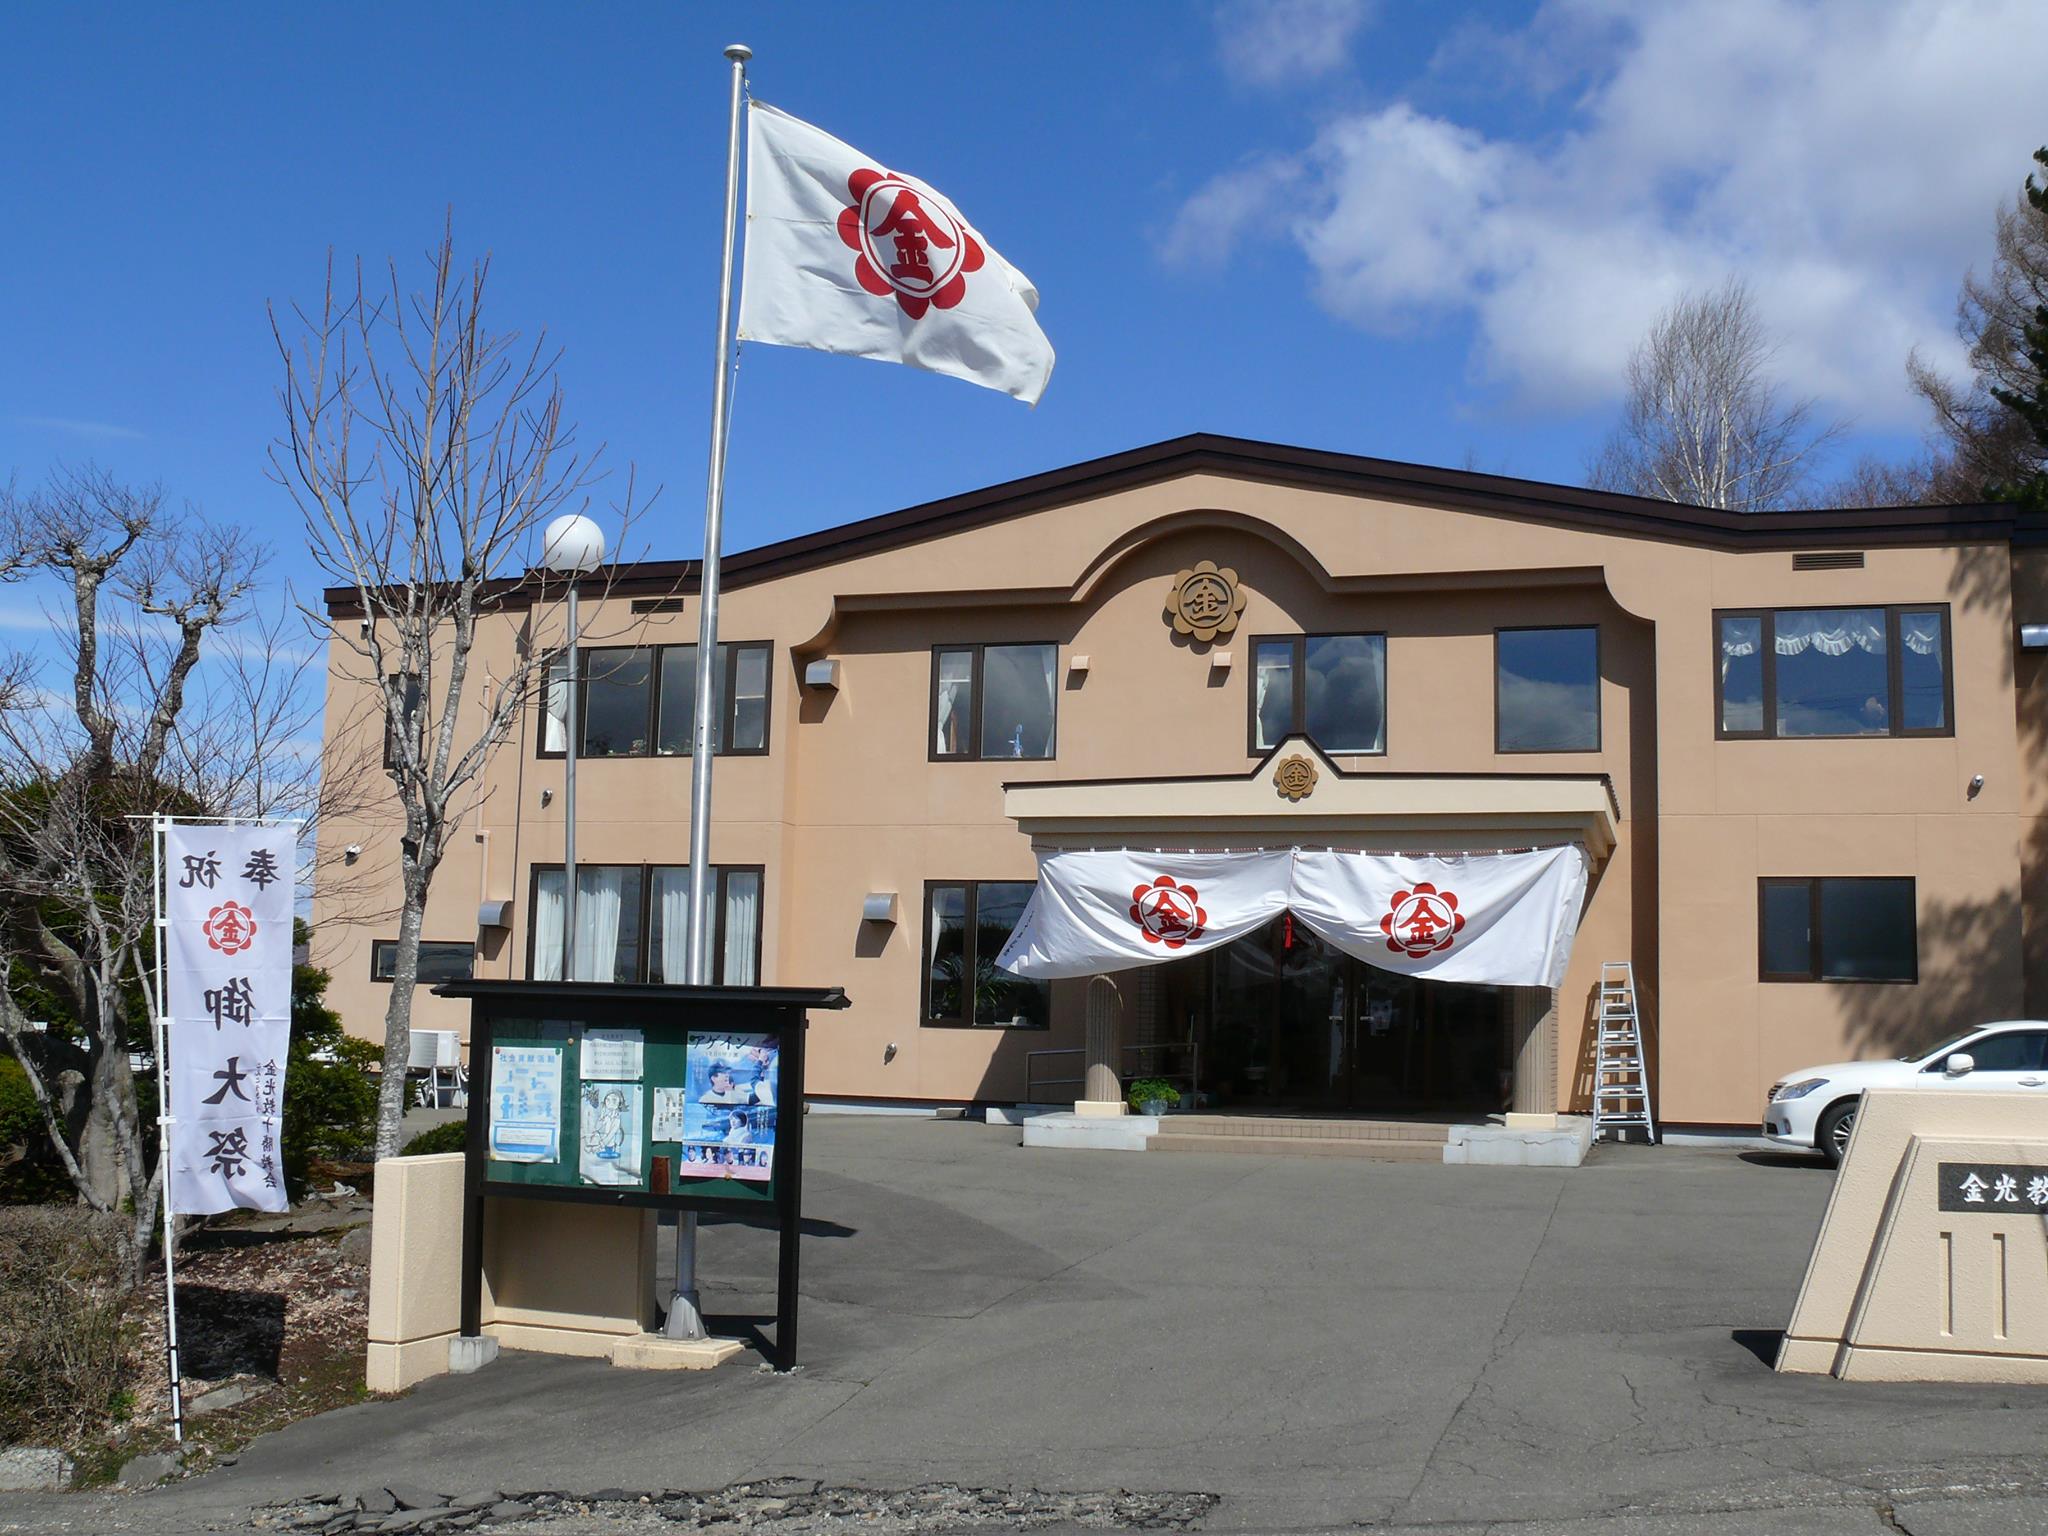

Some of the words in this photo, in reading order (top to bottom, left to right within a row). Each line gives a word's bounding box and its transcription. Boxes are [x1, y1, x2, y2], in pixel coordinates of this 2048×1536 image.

[869, 189, 956, 285] 金
[1183, 578, 1229, 622] 金
[1145, 890, 1192, 934] 金
[1396, 896, 1450, 946] 金
[692, 1035, 750, 1050] アゲイン
